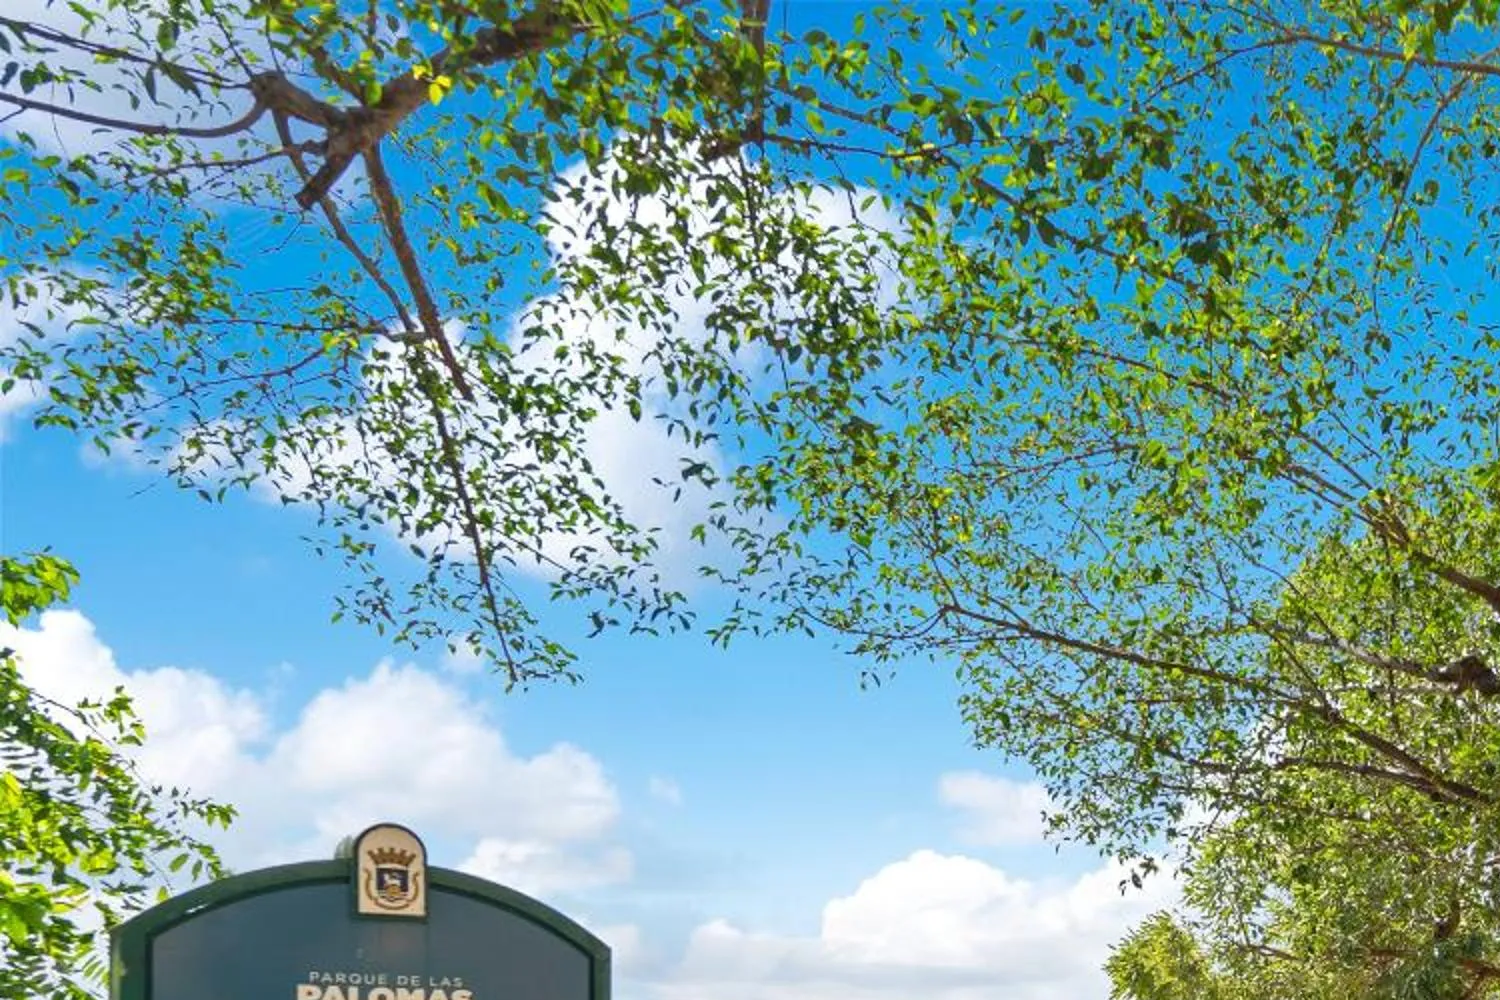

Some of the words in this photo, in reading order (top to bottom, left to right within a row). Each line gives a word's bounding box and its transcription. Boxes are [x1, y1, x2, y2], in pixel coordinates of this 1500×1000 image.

[309, 971, 387, 986] PARQUE
[397, 974, 421, 987] DE
[429, 976, 463, 988] LAS
